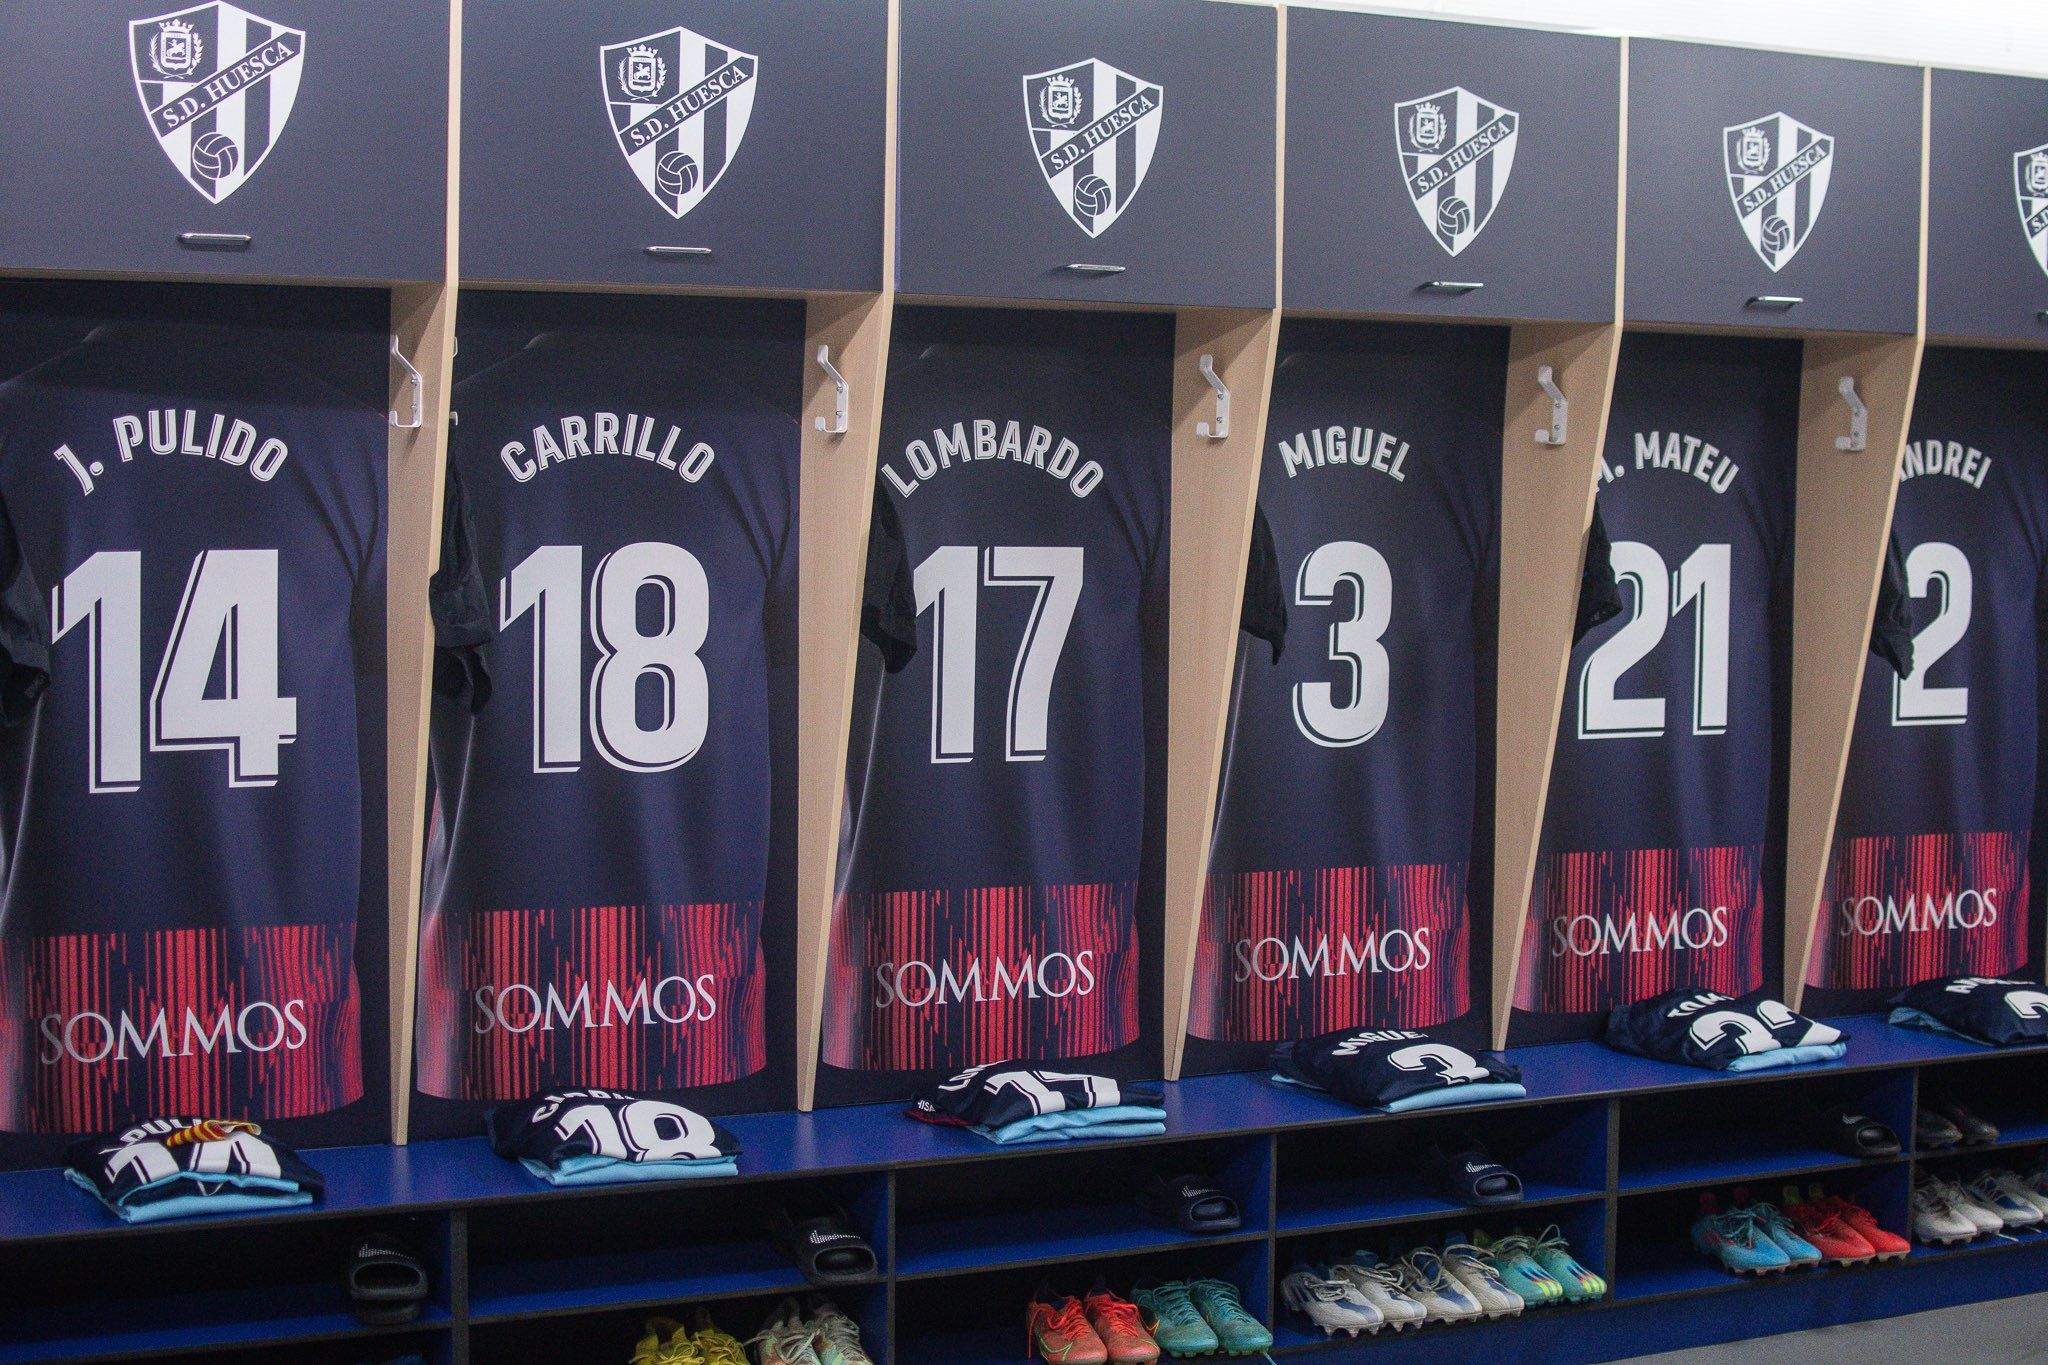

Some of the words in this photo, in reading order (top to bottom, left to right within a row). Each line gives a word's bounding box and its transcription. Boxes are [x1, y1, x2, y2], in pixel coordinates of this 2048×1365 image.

[163, 97, 206, 128] S.D.
[203, 41, 294, 102] HUESCA
[630, 118, 669, 147] S.D.
[666, 65, 748, 123] HUESCA
[1050, 143, 1085, 170] S.D.
[1082, 95, 1154, 149] HUESCA
[1417, 167, 1448, 192] S.D.
[1446, 121, 1511, 171] HUESCA
[1743, 187, 1771, 213] S.D.
[1770, 144, 1827, 193] HUESCA
[53, 443, 104, 496] J.
[114, 409, 289, 483] PULIDO
[500, 411, 715, 484] CARRILLO
[881, 419, 1104, 499] LOMBARDO
[1278, 425, 1411, 483] MIGUEL
[1634, 431, 1740, 494] MATEU
[1900, 439, 1992, 489] NDREI
[500, 541, 709, 773] 18
[913, 546, 1084, 764] 17
[1292, 540, 1393, 748] 3
[1578, 541, 1731, 740] 21
[1892, 541, 1973, 726] 2
[51, 549, 297, 794] 14
[1552, 906, 1728, 957] SOMMOS
[1840, 887, 1997, 936] SOMMOS
[875, 950, 1095, 1009] SOMMOS
[1234, 927, 1431, 983] SOMMOS
[40, 1000, 307, 1065] SOMMOS
[475, 974, 716, 1034] SOMMOS
[1331, 1030, 1429, 1056] MIGUE
